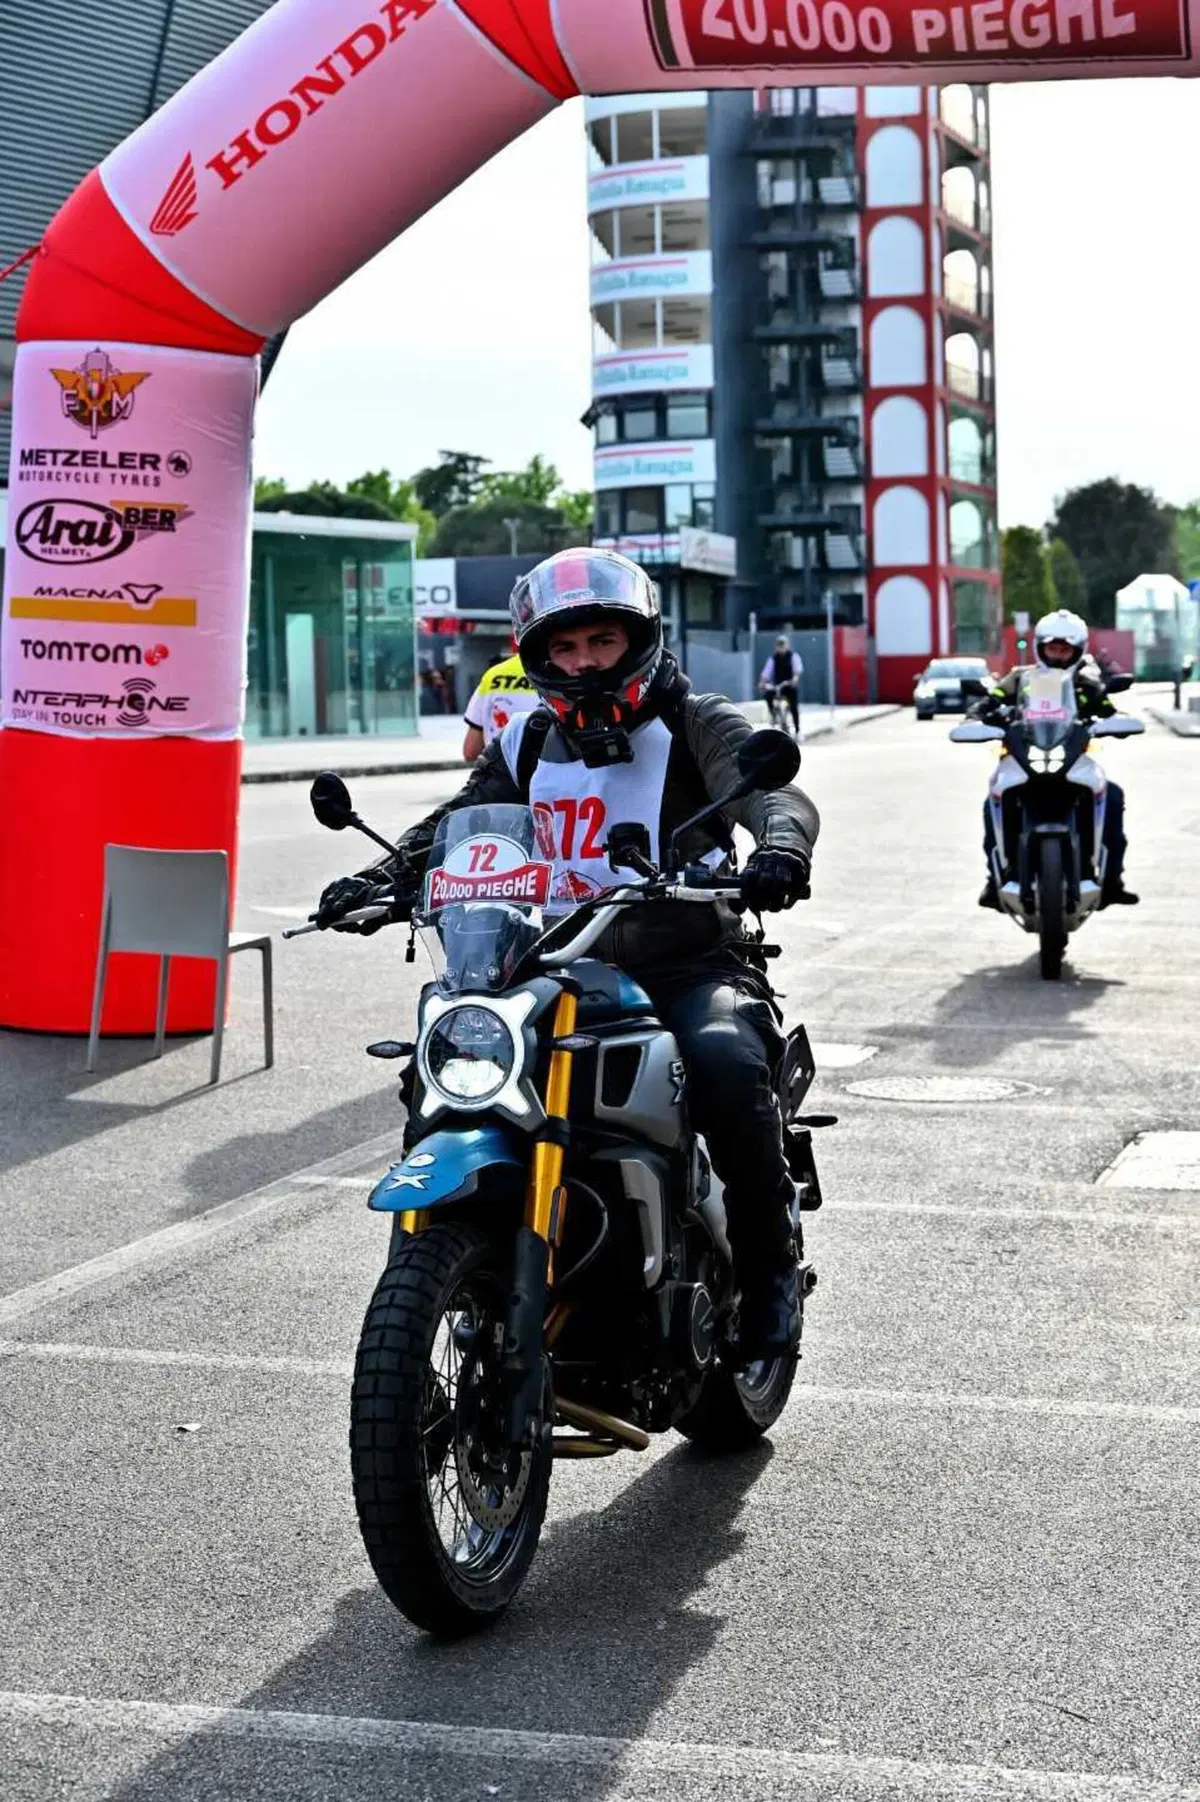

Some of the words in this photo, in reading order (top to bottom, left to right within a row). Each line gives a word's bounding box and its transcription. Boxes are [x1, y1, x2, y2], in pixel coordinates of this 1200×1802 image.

[205, 0, 437, 190] HONDA
[19, 448, 161, 471] METZELER
[18, 470, 100, 484] MOTORCYCLE
[110, 473, 161, 487] TYRES
[19, 505, 117, 547] Arai
[124, 507, 177, 526] BER
[40, 547, 86, 557] HELMET
[33, 586, 124, 600] MACNA
[490, 675, 534, 690] STA
[52, 711, 106, 726] TOUCH
[533, 796, 608, 861] 072
[468, 842, 498, 873] 72
[433, 875, 472, 900] 20.000
[476, 870, 538, 897] PIEGHE
